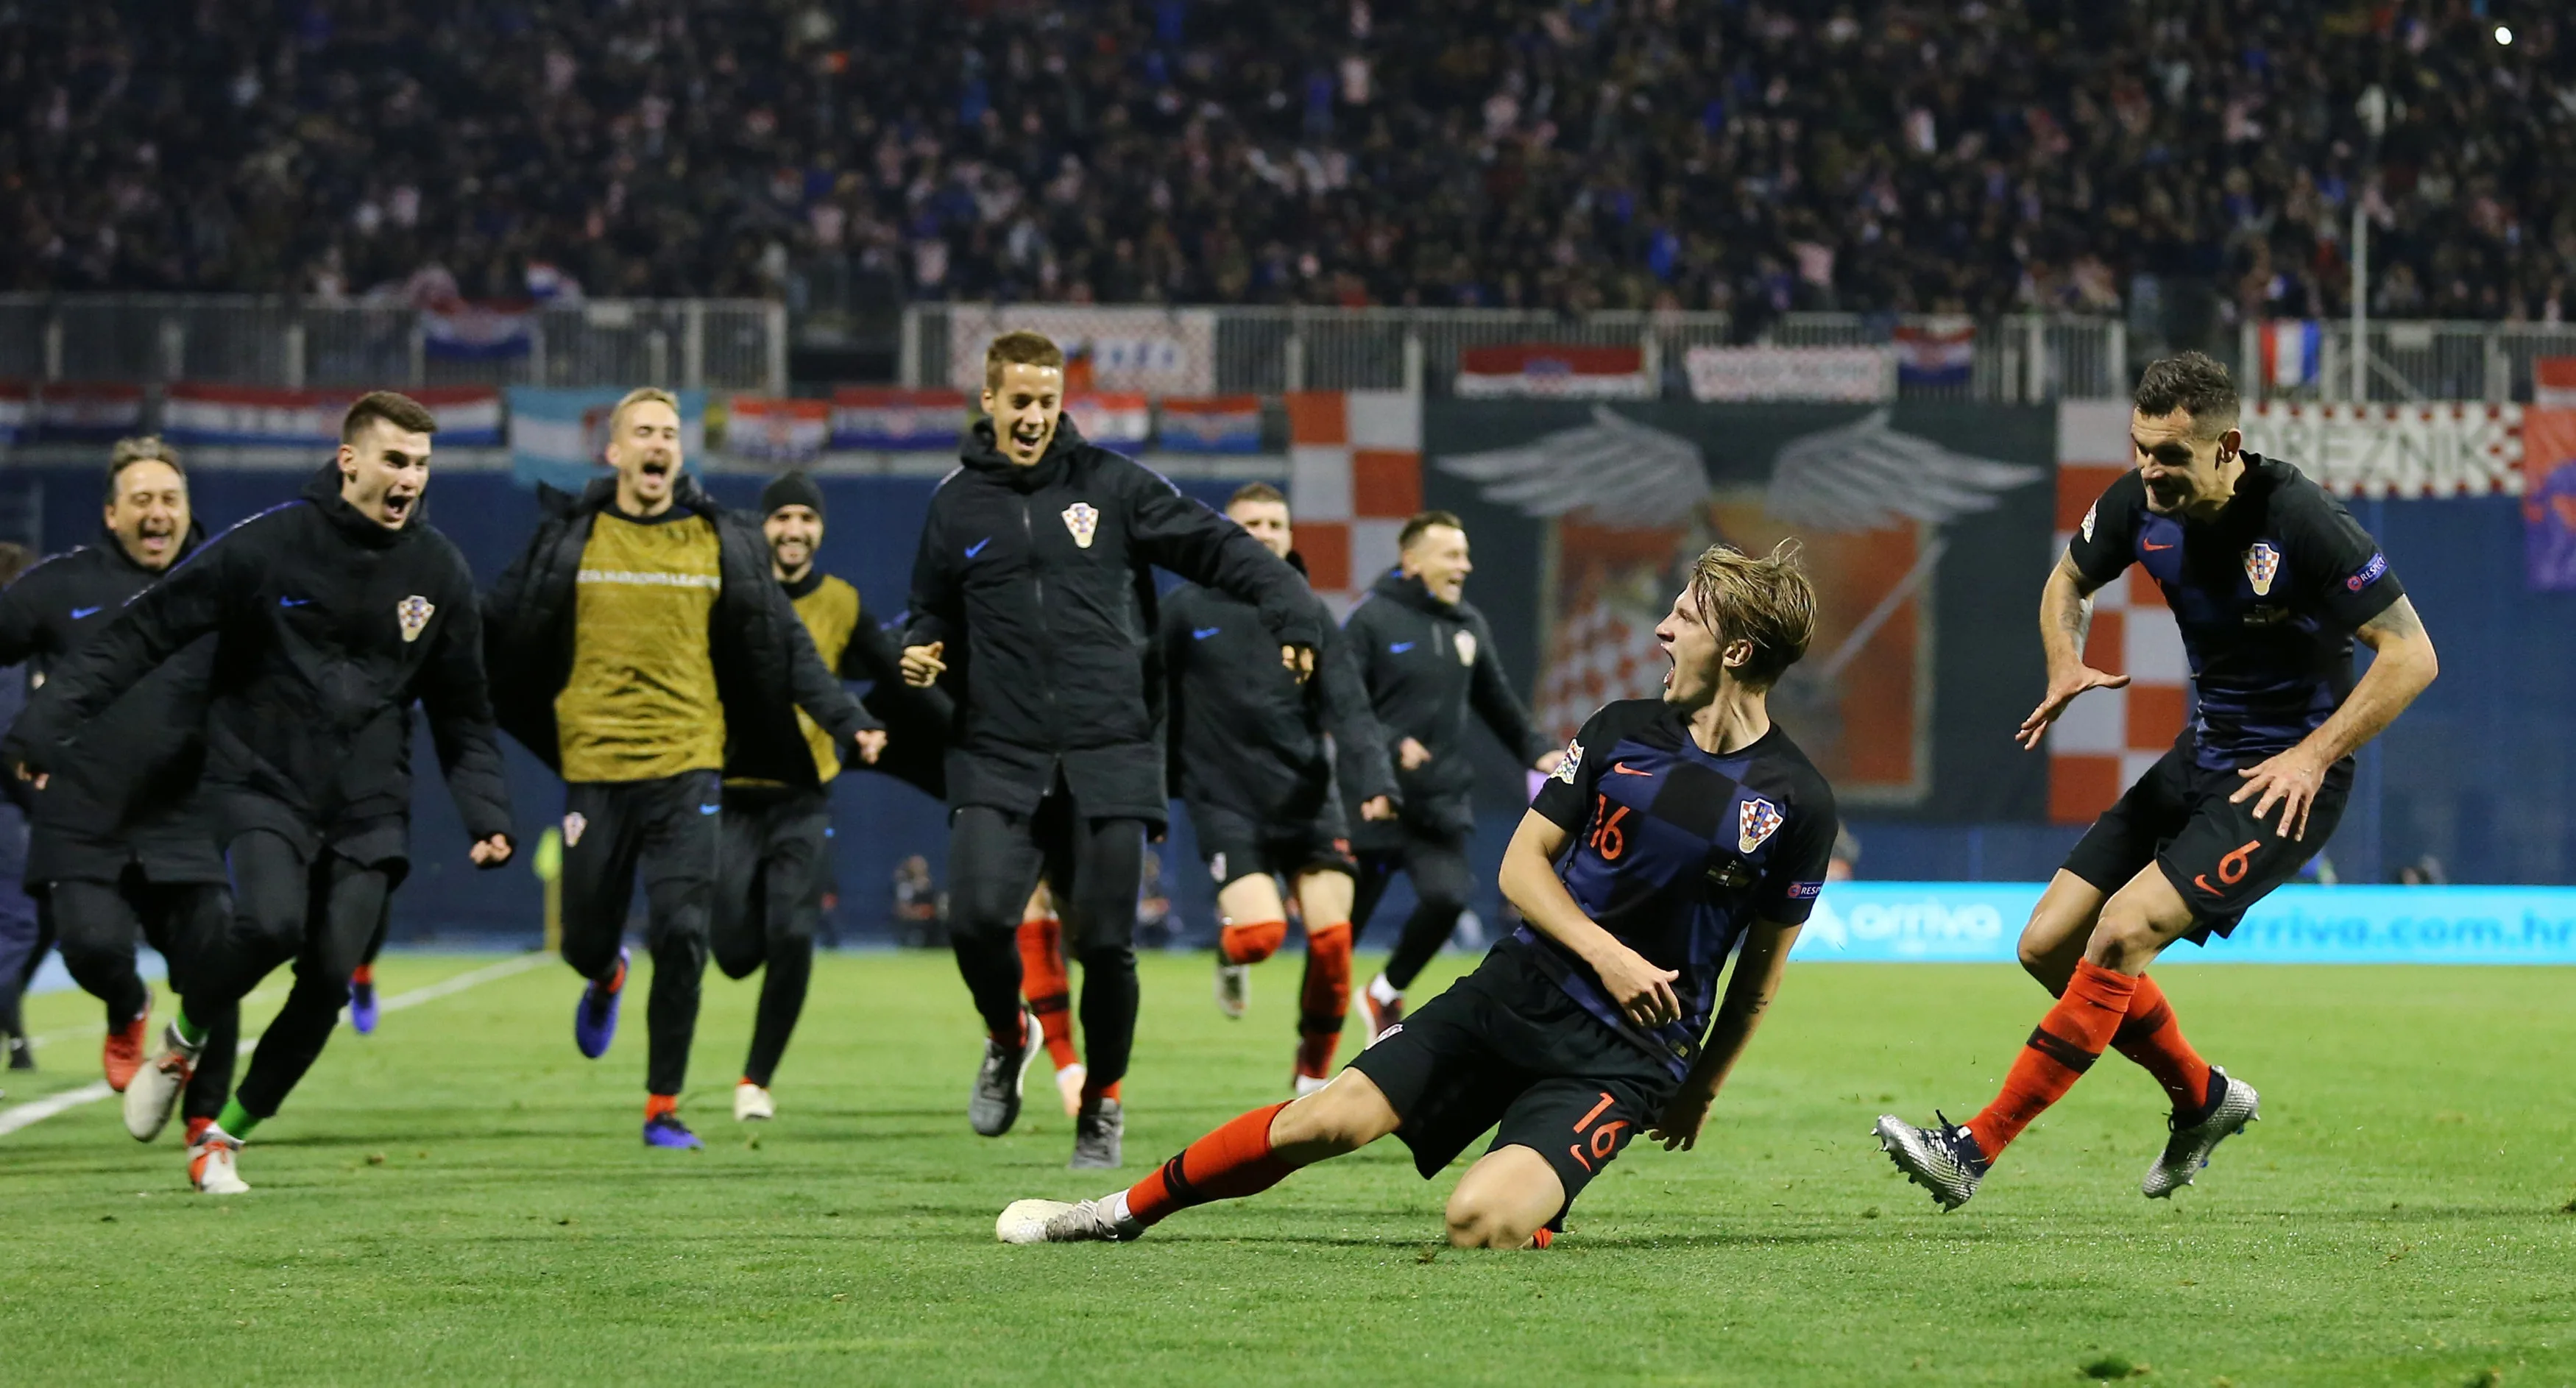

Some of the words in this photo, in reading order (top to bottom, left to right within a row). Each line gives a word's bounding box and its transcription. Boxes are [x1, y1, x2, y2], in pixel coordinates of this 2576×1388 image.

[1590, 793, 1631, 860] 16
[2218, 840, 2261, 885] 6
[1850, 897, 2001, 941] arriva
[1573, 1091, 1630, 1159] 16
